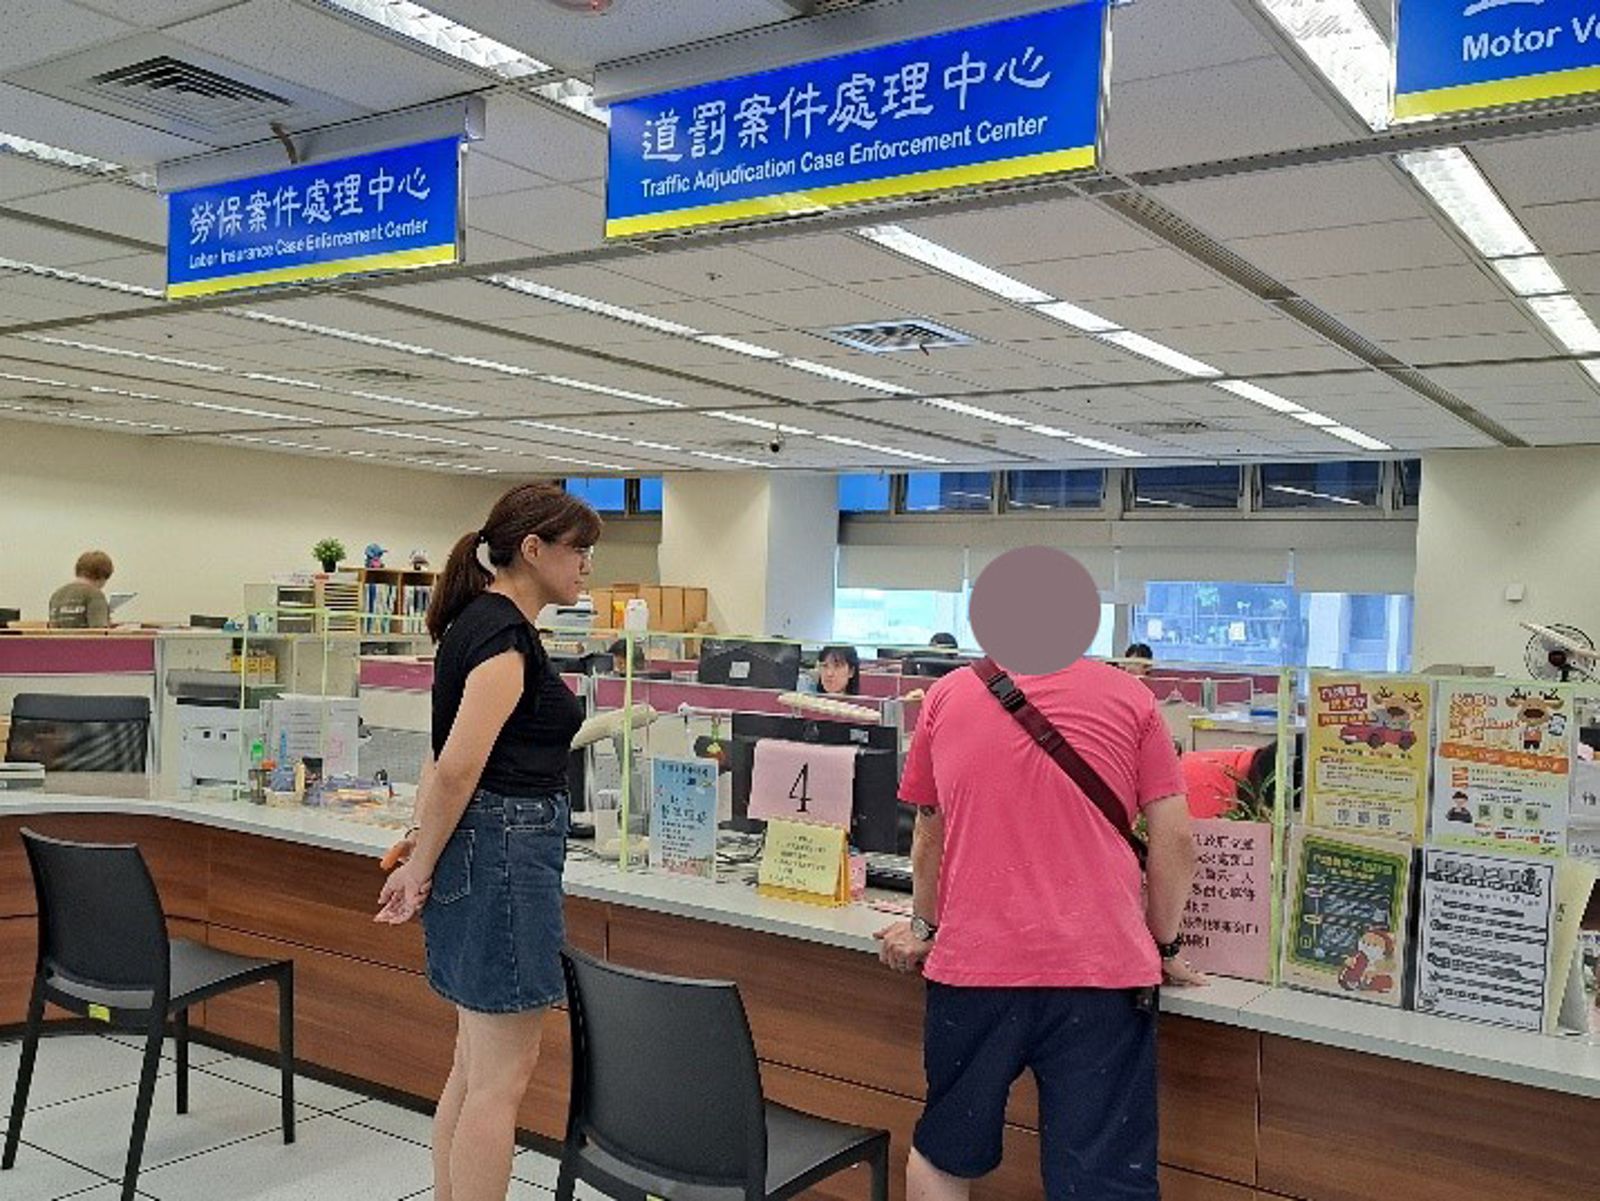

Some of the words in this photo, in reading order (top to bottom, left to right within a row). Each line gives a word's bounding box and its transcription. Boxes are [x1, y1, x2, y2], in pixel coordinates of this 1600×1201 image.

[1463, 27, 1562, 61] Motor
[641, 46, 1052, 162] 道罰案件處理中心
[641, 174, 690, 197] Traffic
[693, 158, 796, 192] Adjudication
[800, 150, 845, 173] Case
[850, 126, 972, 164] Enforcement
[976, 116, 1048, 144] Center
[189, 167, 431, 245] 勞保案件處理中心
[220, 244, 274, 265] Insurance
[276, 238, 305, 256] Case
[306, 226, 383, 250] Enforcement
[384, 219, 429, 239] Center
[788, 763, 813, 813] 4
